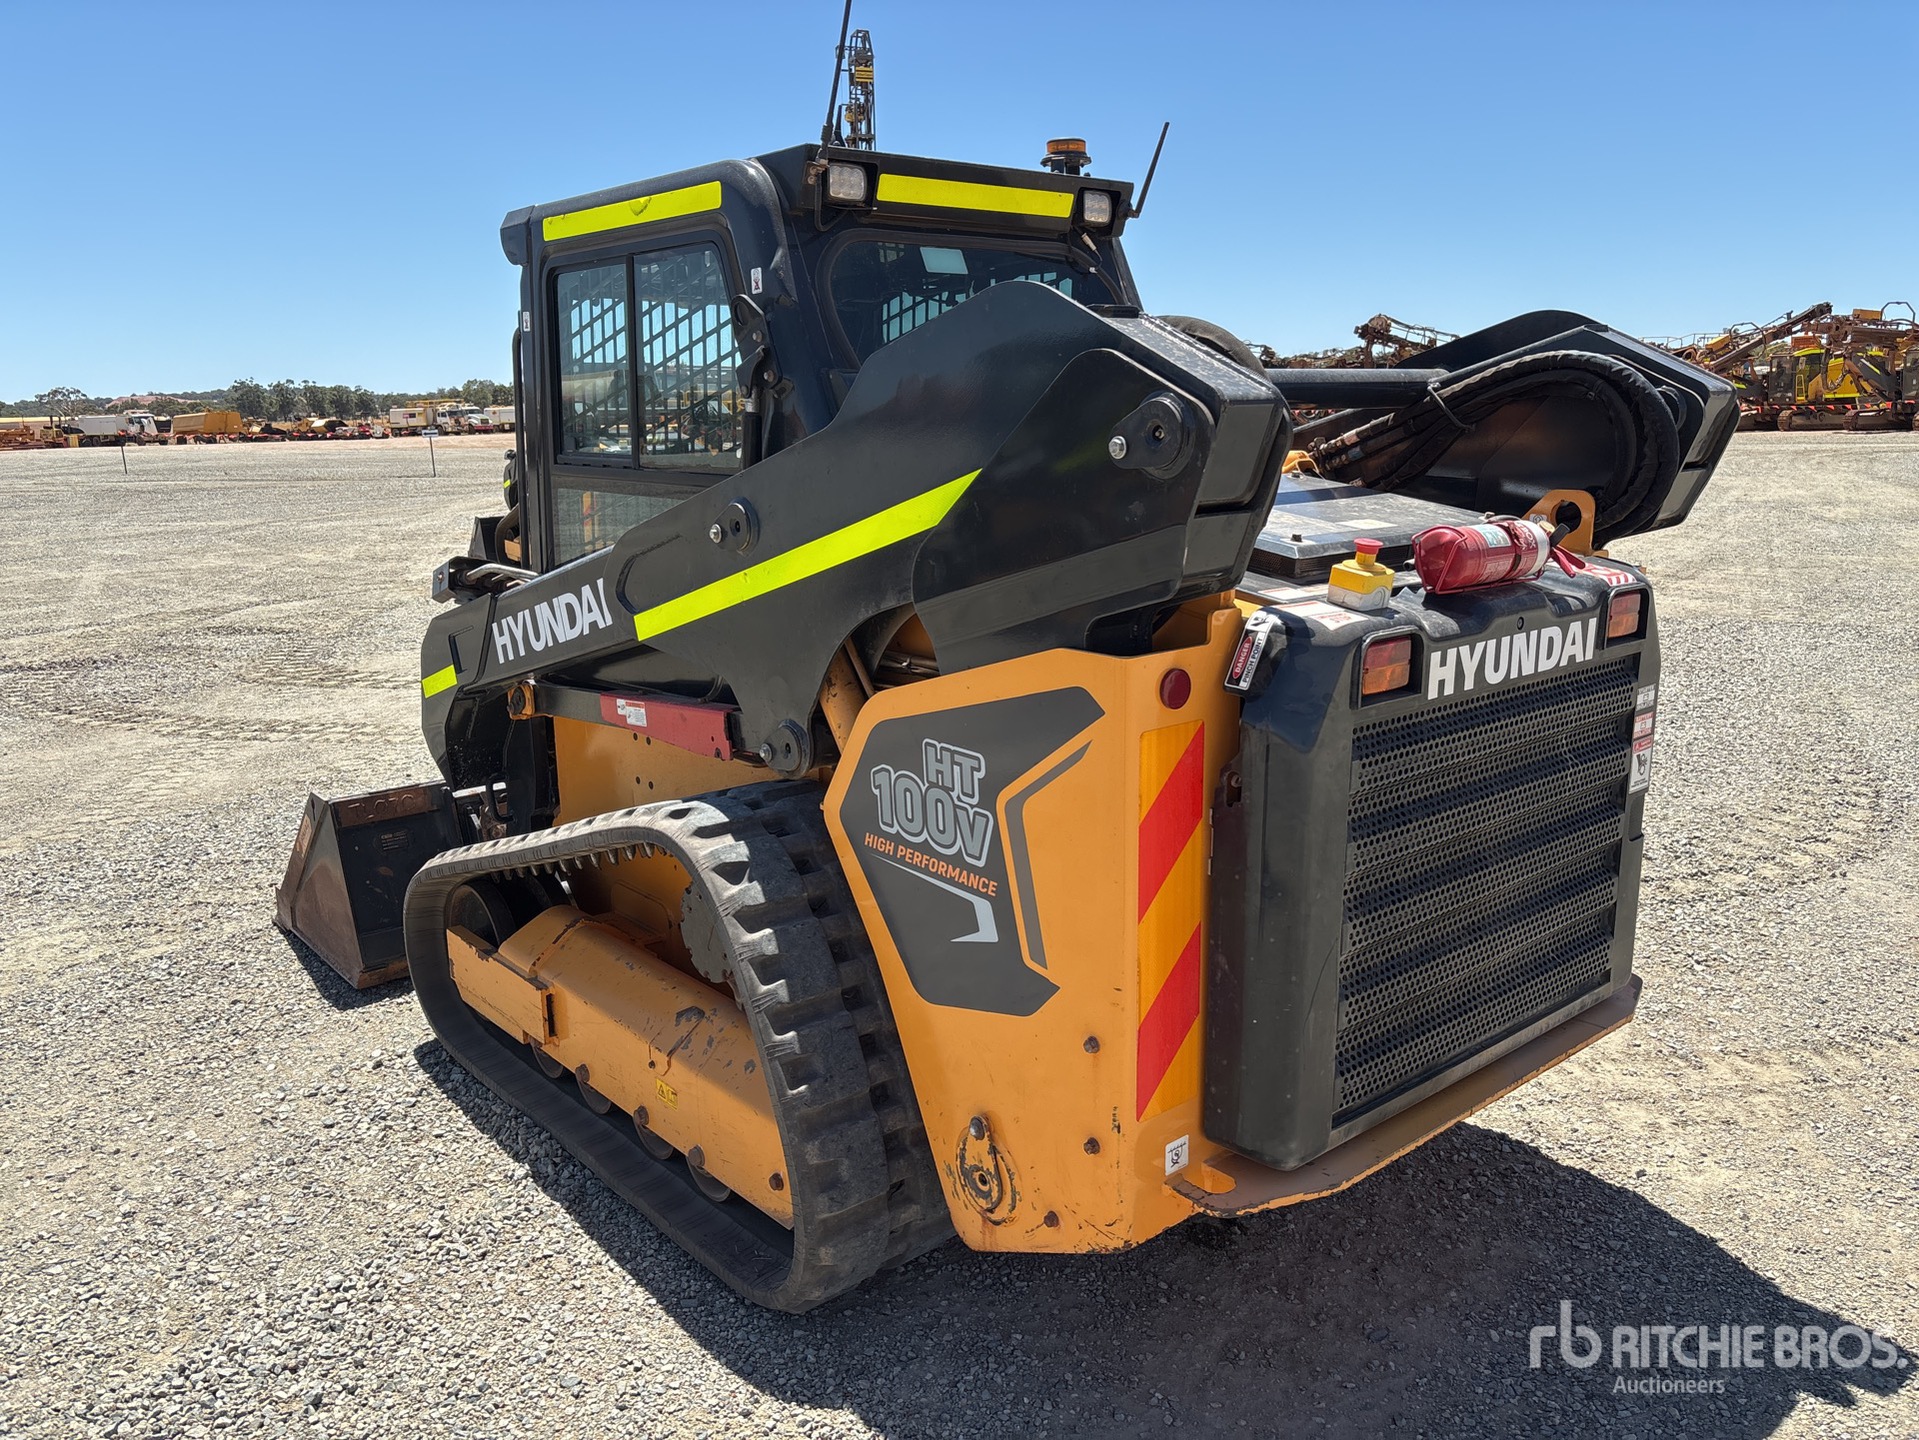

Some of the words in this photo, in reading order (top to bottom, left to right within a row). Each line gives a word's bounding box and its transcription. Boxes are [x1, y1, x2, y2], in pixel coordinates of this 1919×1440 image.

[492, 578, 613, 664] HYUNDAI
[1235, 642, 1250, 673] DANGER
[1242, 660, 1255, 683] PINCH
[1251, 638, 1263, 660] POINT
[1427, 617, 1597, 700] HYUNDAI
[923, 738, 986, 804] HT
[870, 764, 994, 867] 100V
[864, 832, 894, 855] HIGH
[897, 845, 998, 897] PERFORMANCE
